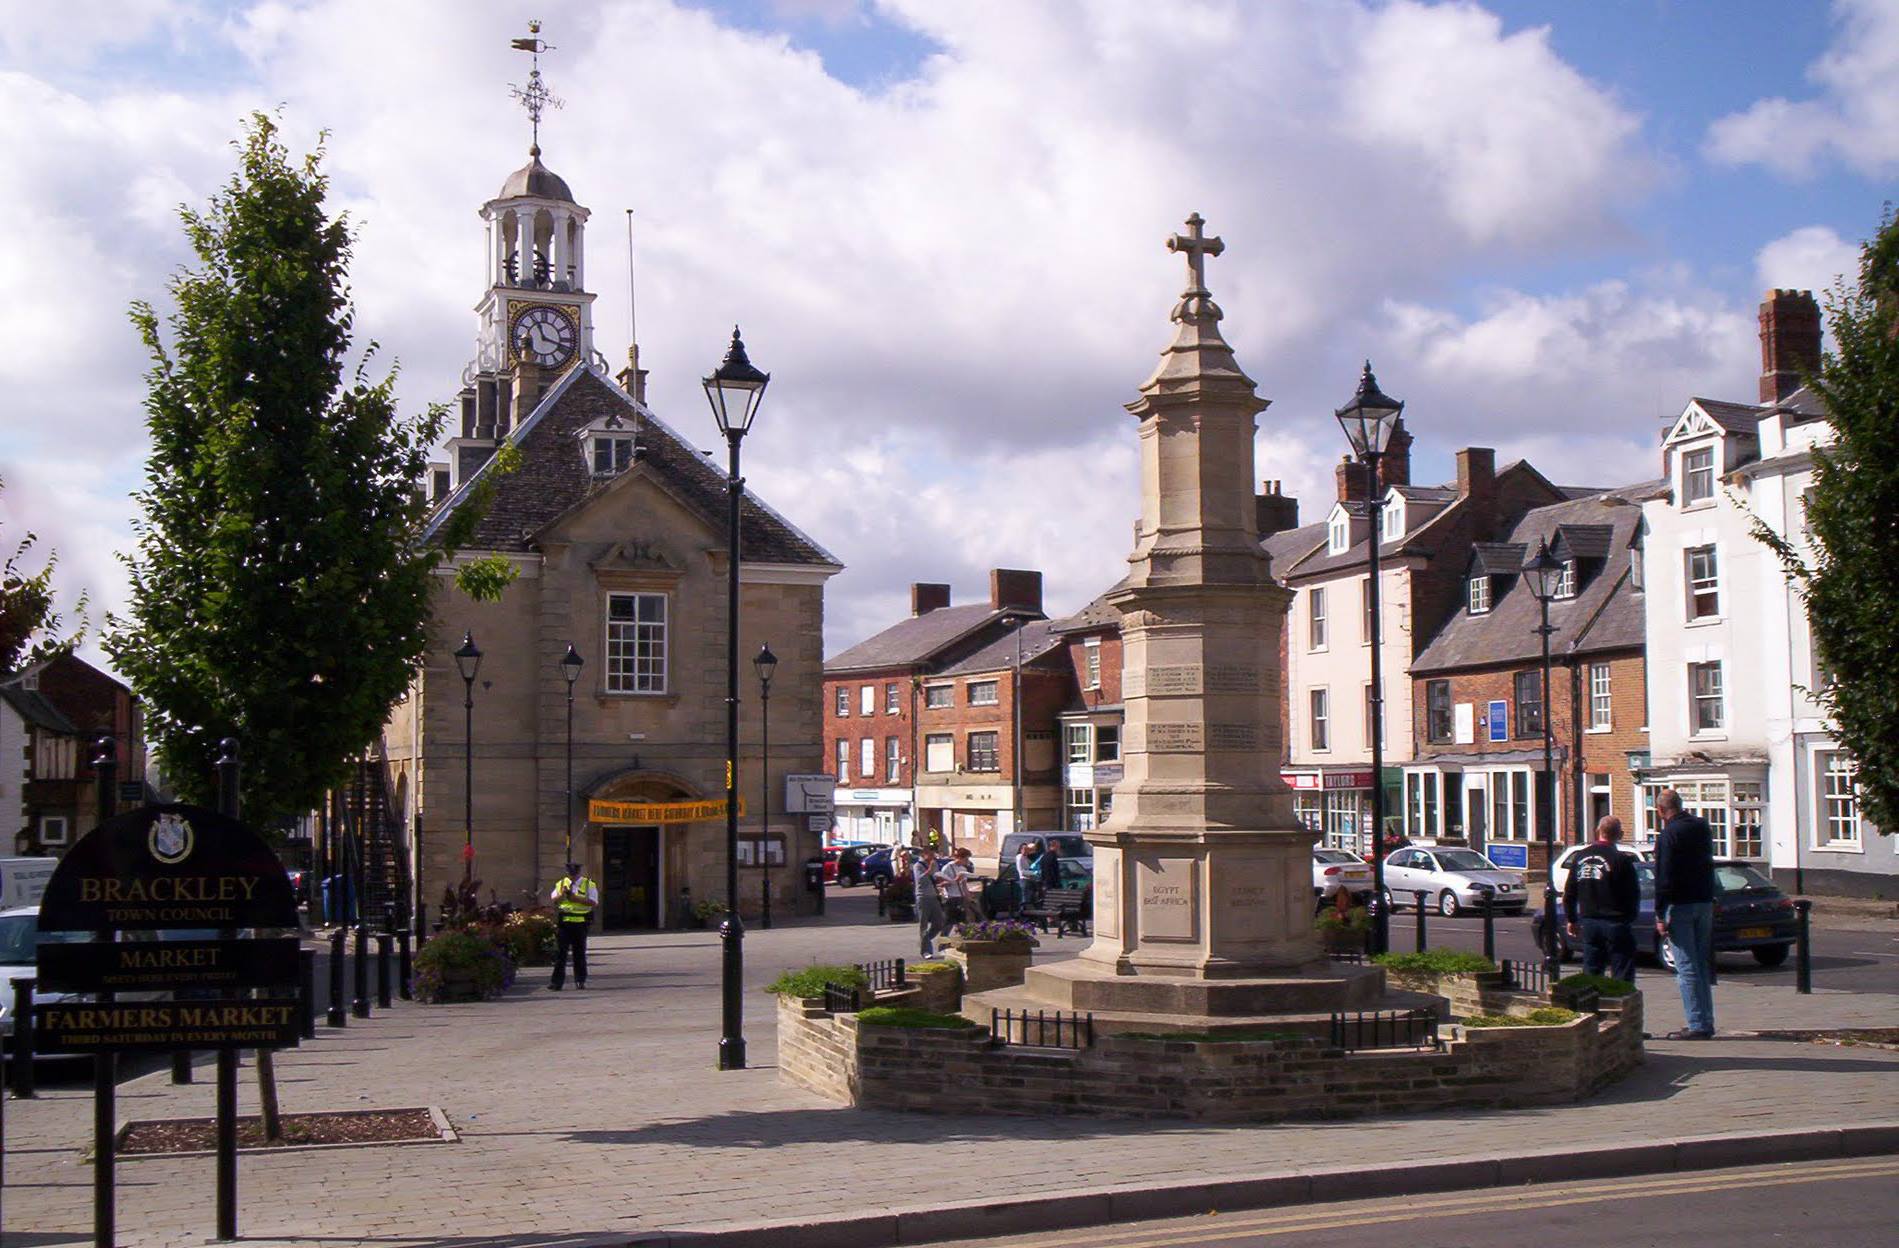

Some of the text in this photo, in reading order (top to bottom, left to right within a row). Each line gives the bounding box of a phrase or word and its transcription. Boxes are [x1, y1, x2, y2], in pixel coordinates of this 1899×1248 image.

[79, 876, 260, 902] BRACKLEY
[105, 906, 235, 922] TOWN COUNCIL
[119, 947, 223, 968] MARKET
[45, 1006, 294, 1030] FARMERS MARKET
[103, 1032, 168, 1044] SATURDAY
[170, 1032, 185, 1042] IN
[186, 1031, 230, 1042] EVERY
[231, 1030, 277, 1041] MONTH
